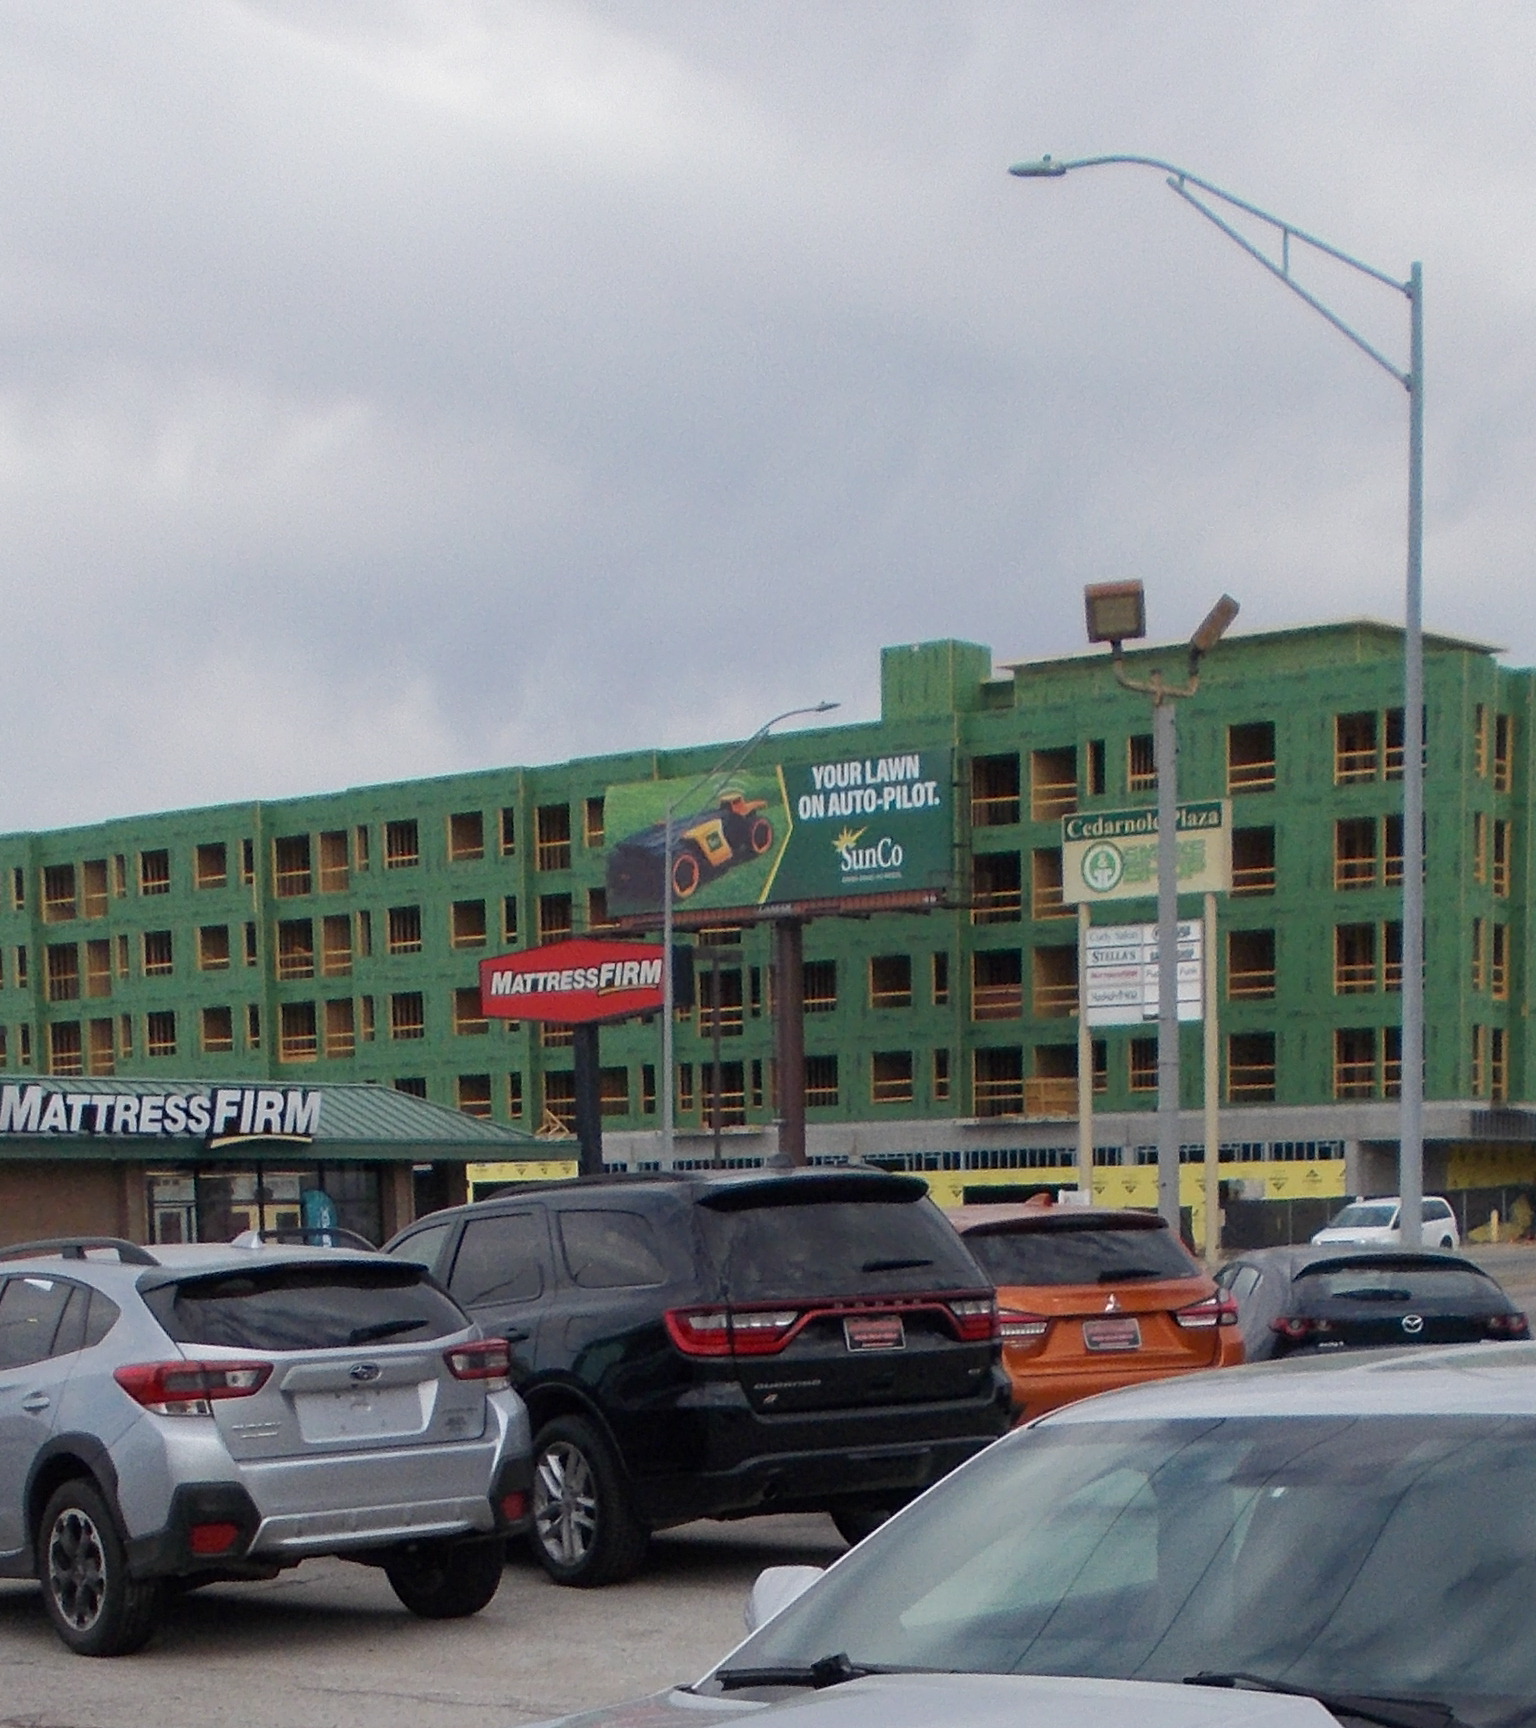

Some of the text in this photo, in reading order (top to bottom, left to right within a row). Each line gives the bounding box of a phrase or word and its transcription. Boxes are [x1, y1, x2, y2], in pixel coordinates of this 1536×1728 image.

[812, 754, 920, 790] YOUR LAWN
[799, 781, 941, 820] ON AUTO-PILOT.
[841, 838, 903, 871] SunCo
